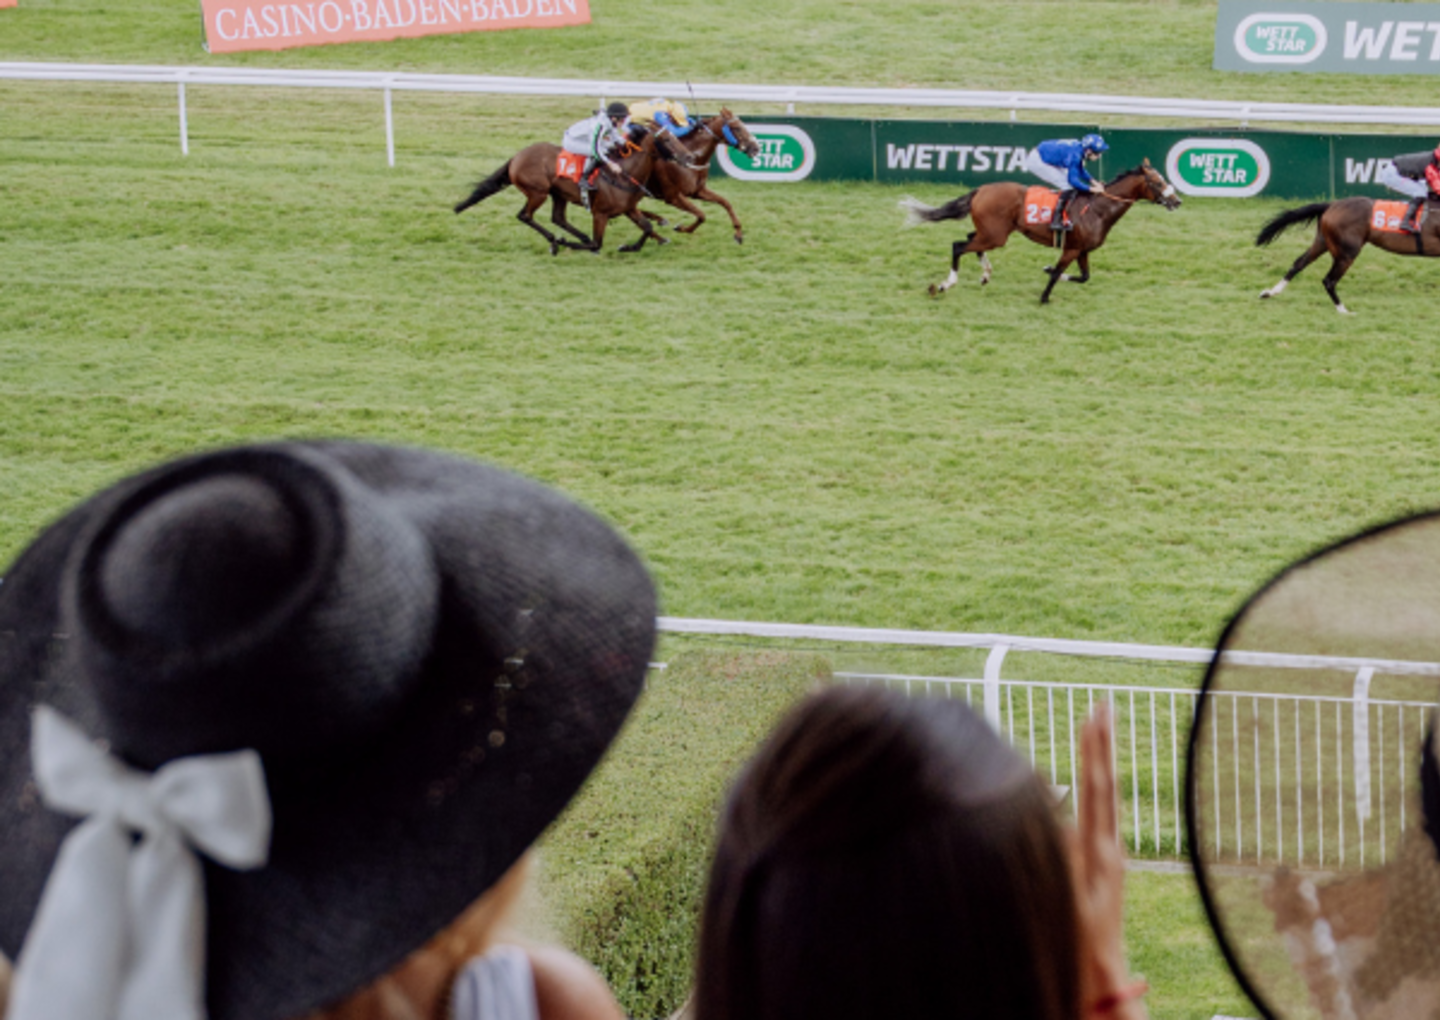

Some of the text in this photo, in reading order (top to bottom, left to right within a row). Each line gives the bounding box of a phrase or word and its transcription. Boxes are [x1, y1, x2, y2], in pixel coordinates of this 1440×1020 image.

[1256, 26, 1299, 39] WETT
[1266, 39, 1306, 51] STAR
[756, 139, 785, 154] ETT
[751, 153, 794, 169] STAR
[886, 143, 1030, 172] WETTSTA
[1190, 153, 1238, 168] WETT
[1202, 167, 1247, 183] STAR
[1026, 203, 1038, 224] 2
[1374, 210, 1386, 228] 6
